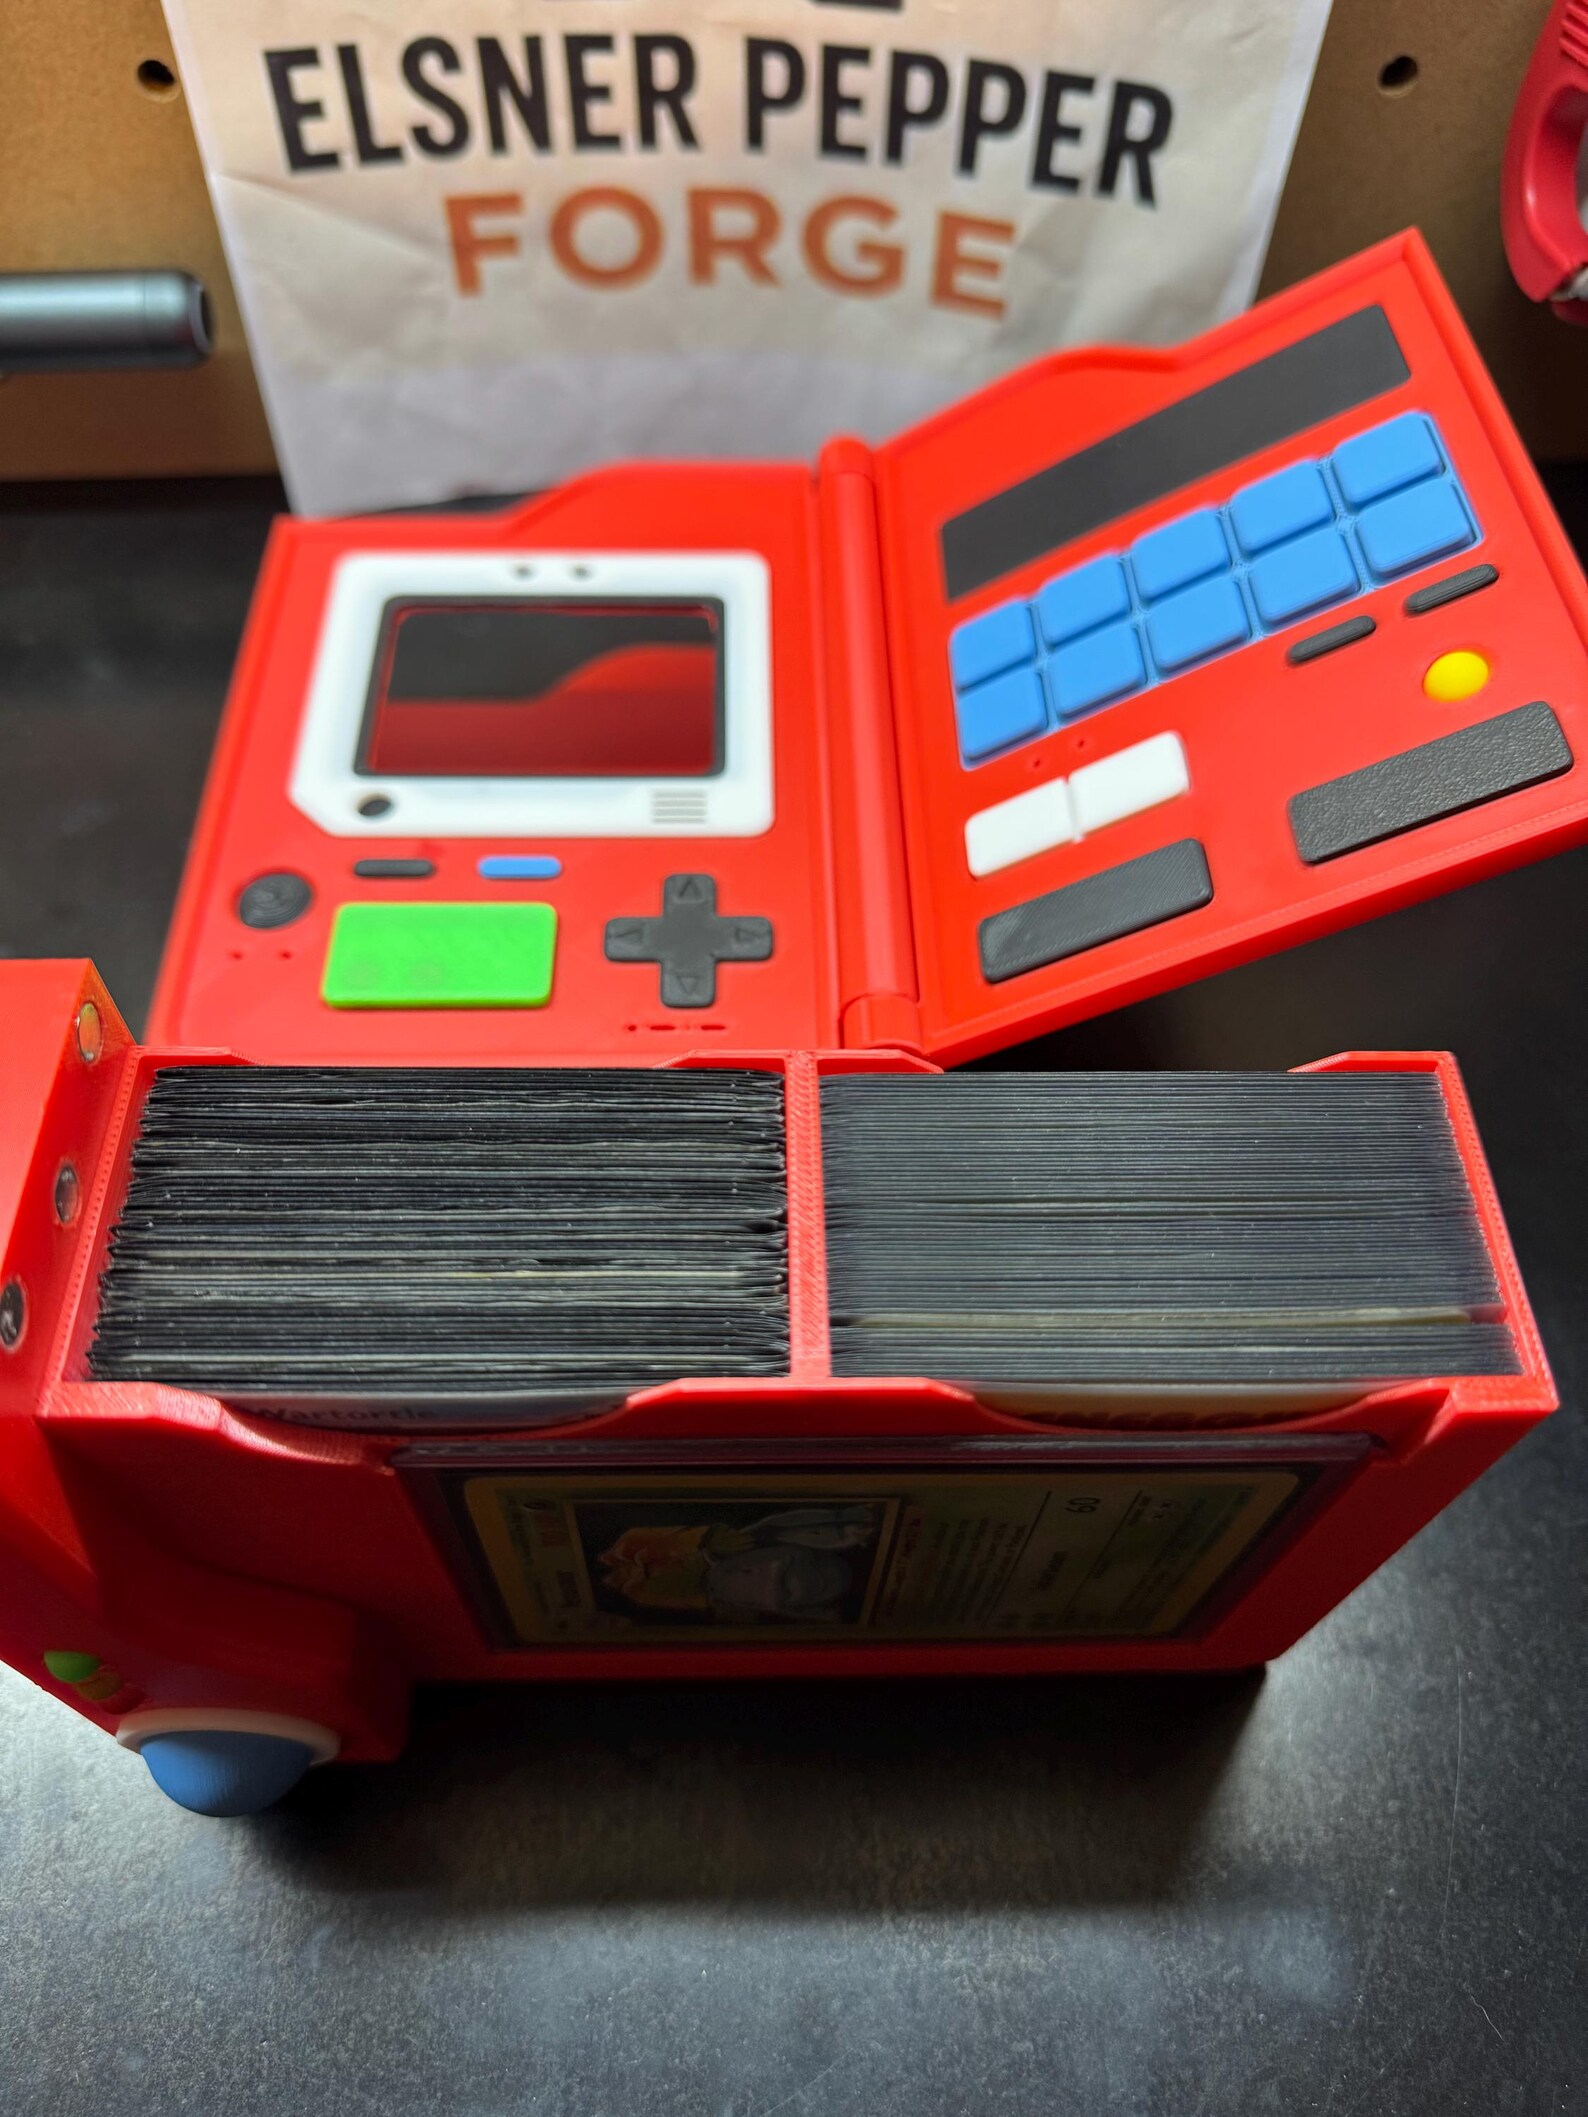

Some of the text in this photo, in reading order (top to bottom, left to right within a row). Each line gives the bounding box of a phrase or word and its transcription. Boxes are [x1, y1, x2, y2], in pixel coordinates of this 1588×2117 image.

[264, 33, 1174, 206] ELSNER PEPPER
[443, 183, 1017, 317] FORGE
[1065, 1497, 1101, 1513] 60
